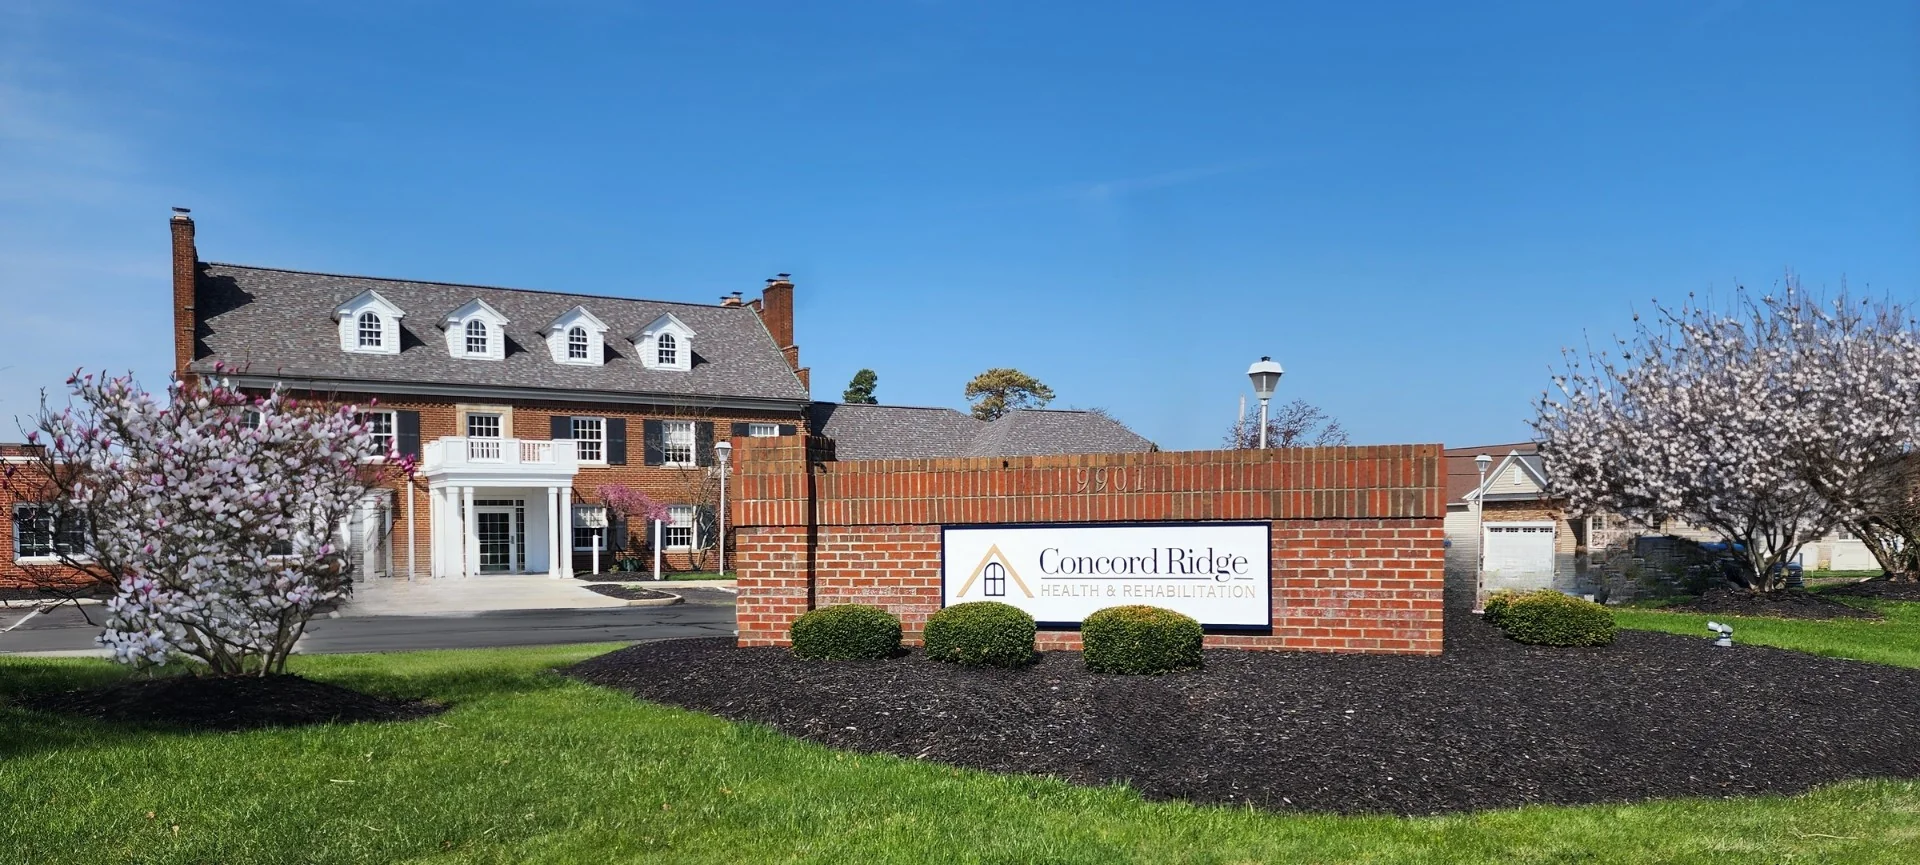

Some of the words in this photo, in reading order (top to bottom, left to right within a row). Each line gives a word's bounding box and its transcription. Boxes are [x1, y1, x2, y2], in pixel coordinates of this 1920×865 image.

[1076, 467, 1144, 493] 9901
[1039, 547, 1158, 576] Concord
[1165, 547, 1249, 582] Ridge
[1041, 584, 1100, 597] HEALTH
[1106, 584, 1116, 597] &
[1123, 584, 1256, 598] REHABILITATION
